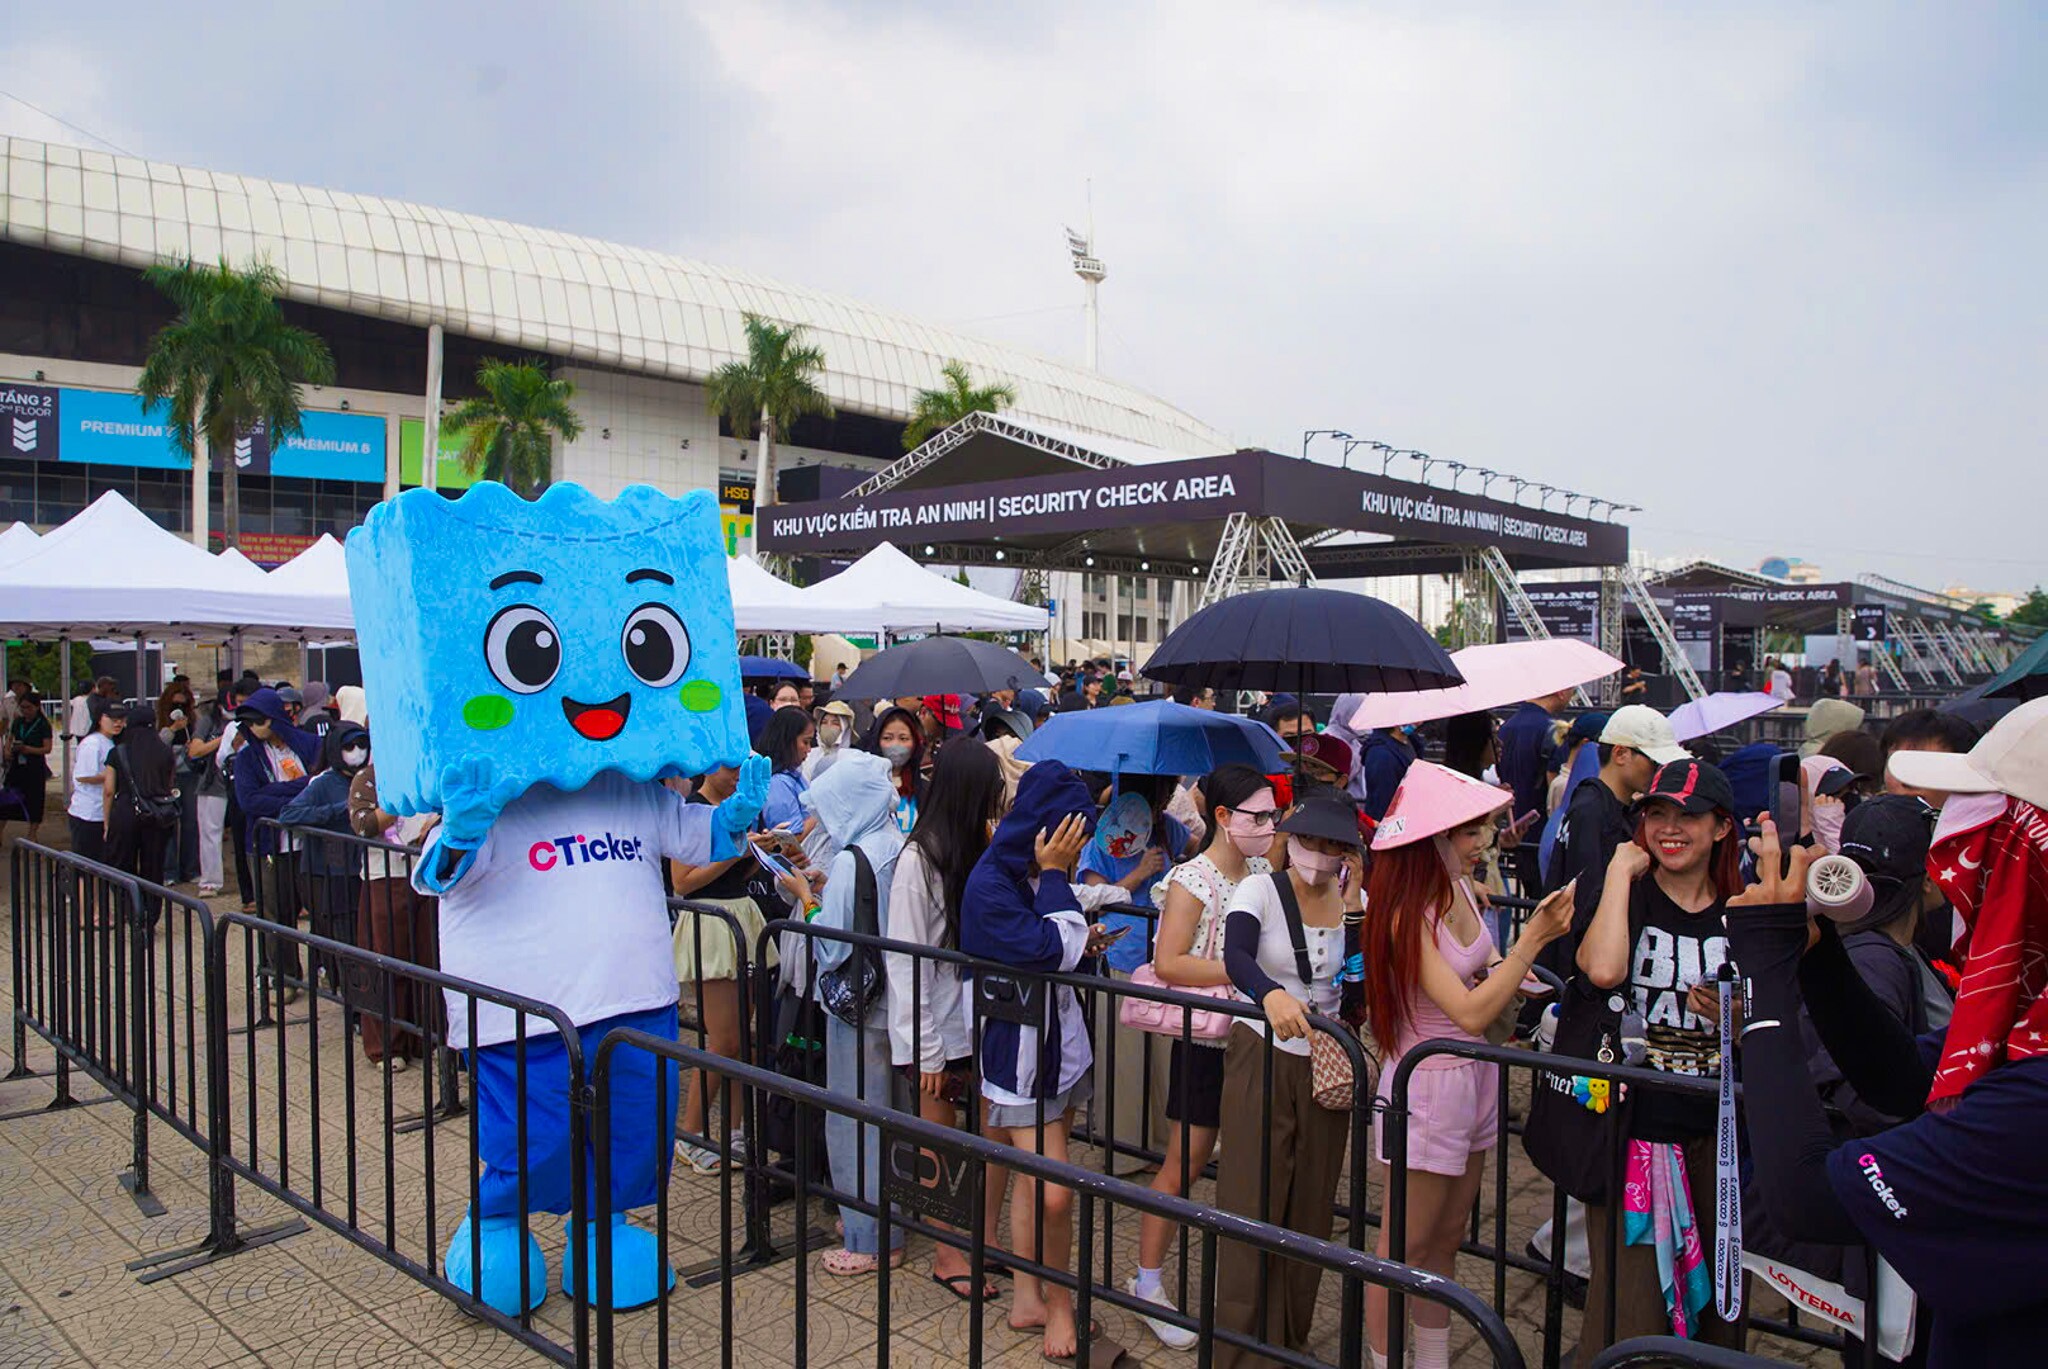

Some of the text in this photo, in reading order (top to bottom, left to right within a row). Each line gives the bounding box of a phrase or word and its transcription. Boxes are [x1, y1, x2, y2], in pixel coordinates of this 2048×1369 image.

[43, 396, 52, 407] 2
[15, 405, 52, 416] FLOOR
[81, 420, 162, 437] PREMIUM
[287, 436, 358, 453] PREMIUM
[724, 487, 749, 500] HSG
[773, 518, 803, 537] KHU
[805, 512, 837, 538] VỰC
[839, 504, 877, 531] KIỂM
[879, 507, 912, 528] TRA
[915, 504, 941, 525] AN
[943, 499, 986, 522] NINH
[998, 488, 1092, 518] SECURITY
[1096, 480, 1168, 508] CHECK
[1172, 474, 1237, 502] AREA
[1362, 490, 1389, 515] KHU
[1440, 505, 1461, 526] TRA
[1461, 509, 1477, 529] AN
[1477, 511, 1499, 532] NINH
[1503, 517, 1543, 541] SECURITY
[1542, 525, 1569, 545] CHECK
[1568, 530, 1588, 548] AREA
[1806, 590, 1838, 600] AREA
[528, 831, 643, 872] CTicket
[1858, 1153, 1908, 1219] CTicket
[1768, 1265, 1856, 1324] LOTTERIA
